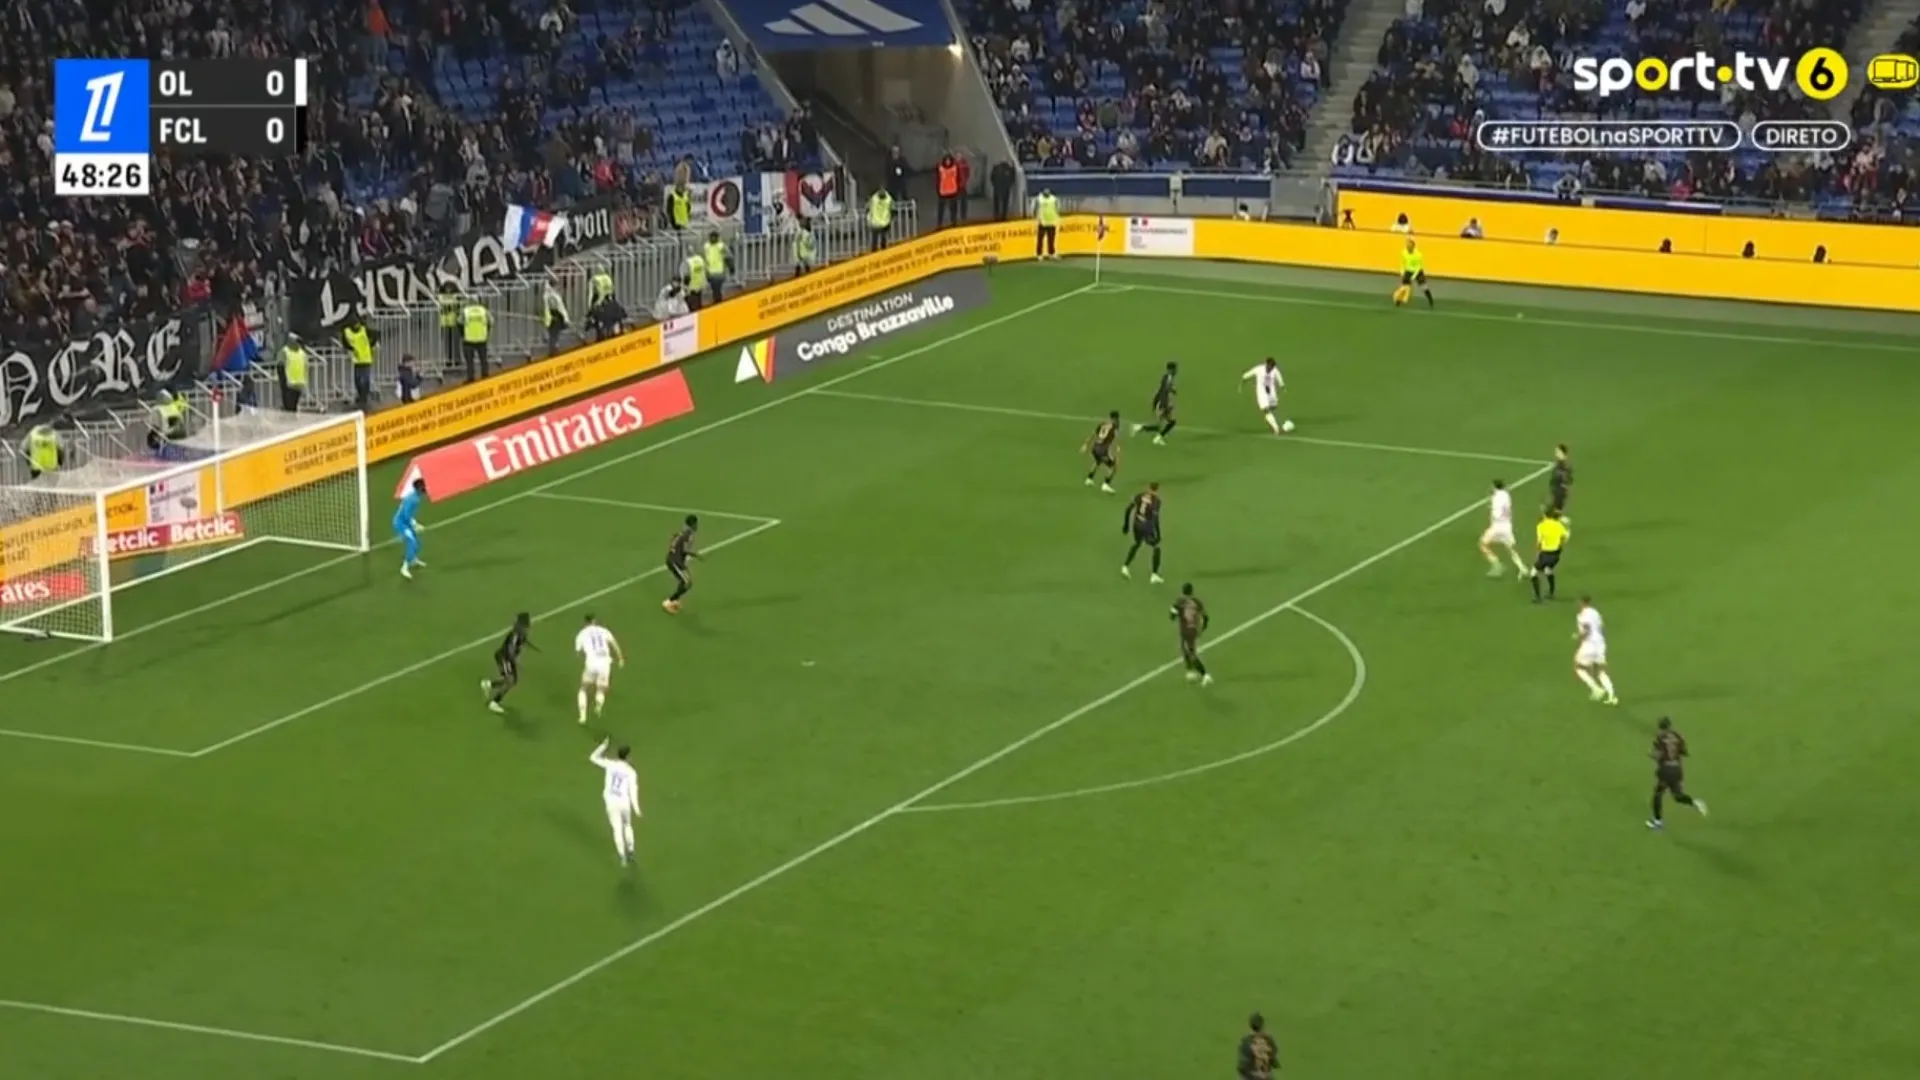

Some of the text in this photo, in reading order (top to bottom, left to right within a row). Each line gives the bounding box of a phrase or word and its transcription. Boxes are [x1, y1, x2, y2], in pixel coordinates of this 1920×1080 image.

[797, 294, 955, 361] Congo Brazzaville
[827, 292, 913, 331] DESTINATION
[474, 396, 643, 482] Emirates
[170, 516, 236, 543] Betclic
